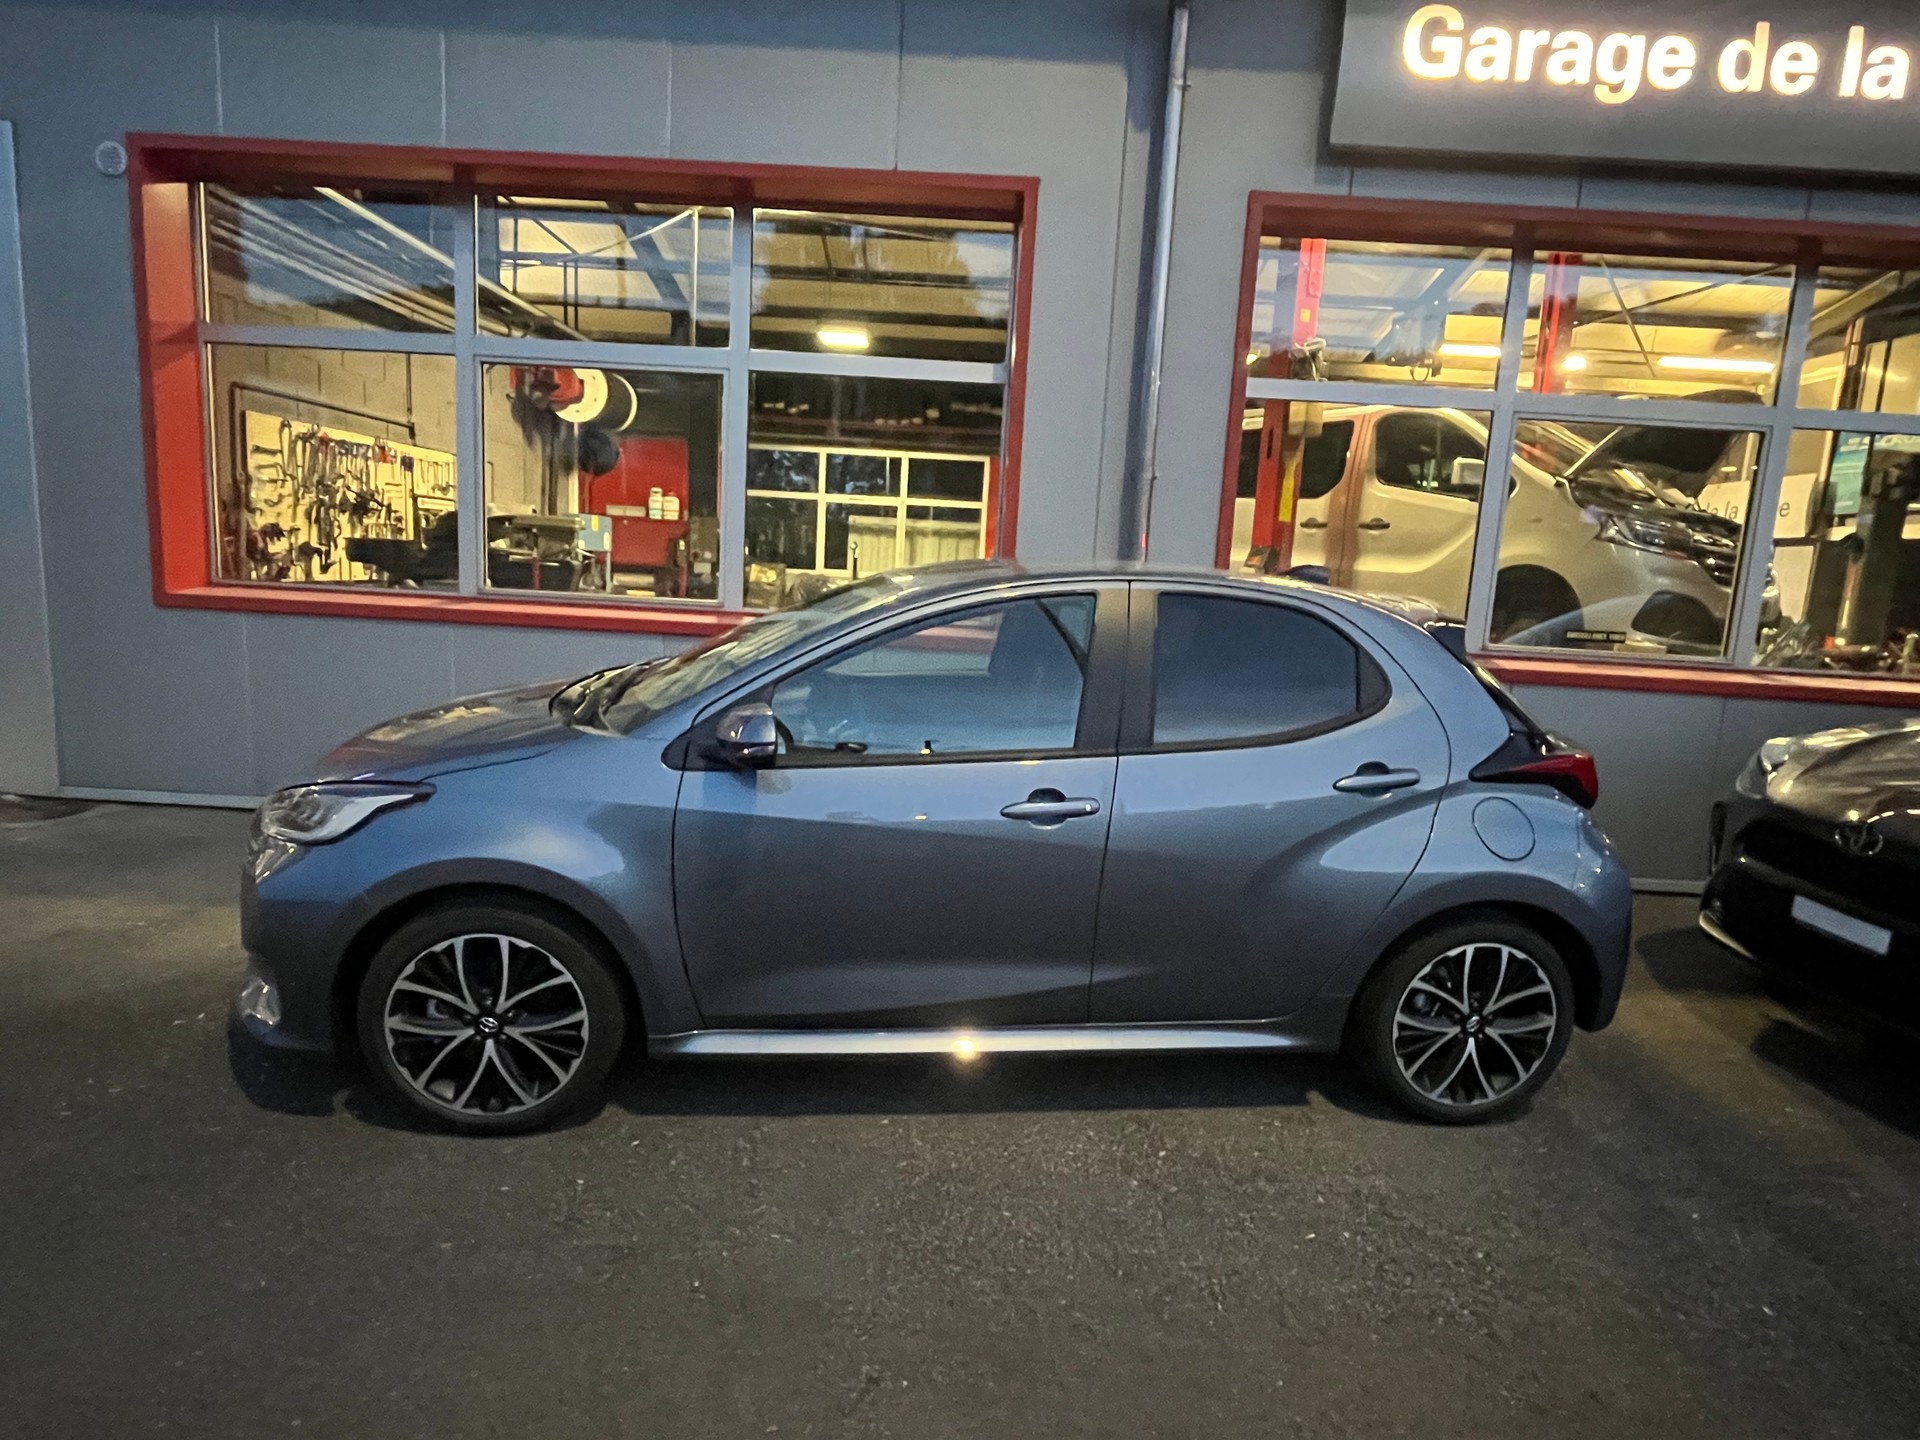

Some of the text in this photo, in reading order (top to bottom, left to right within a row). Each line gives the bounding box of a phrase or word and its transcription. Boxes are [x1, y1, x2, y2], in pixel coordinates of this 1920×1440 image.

[1401, 4, 1911, 104] Garage de la
